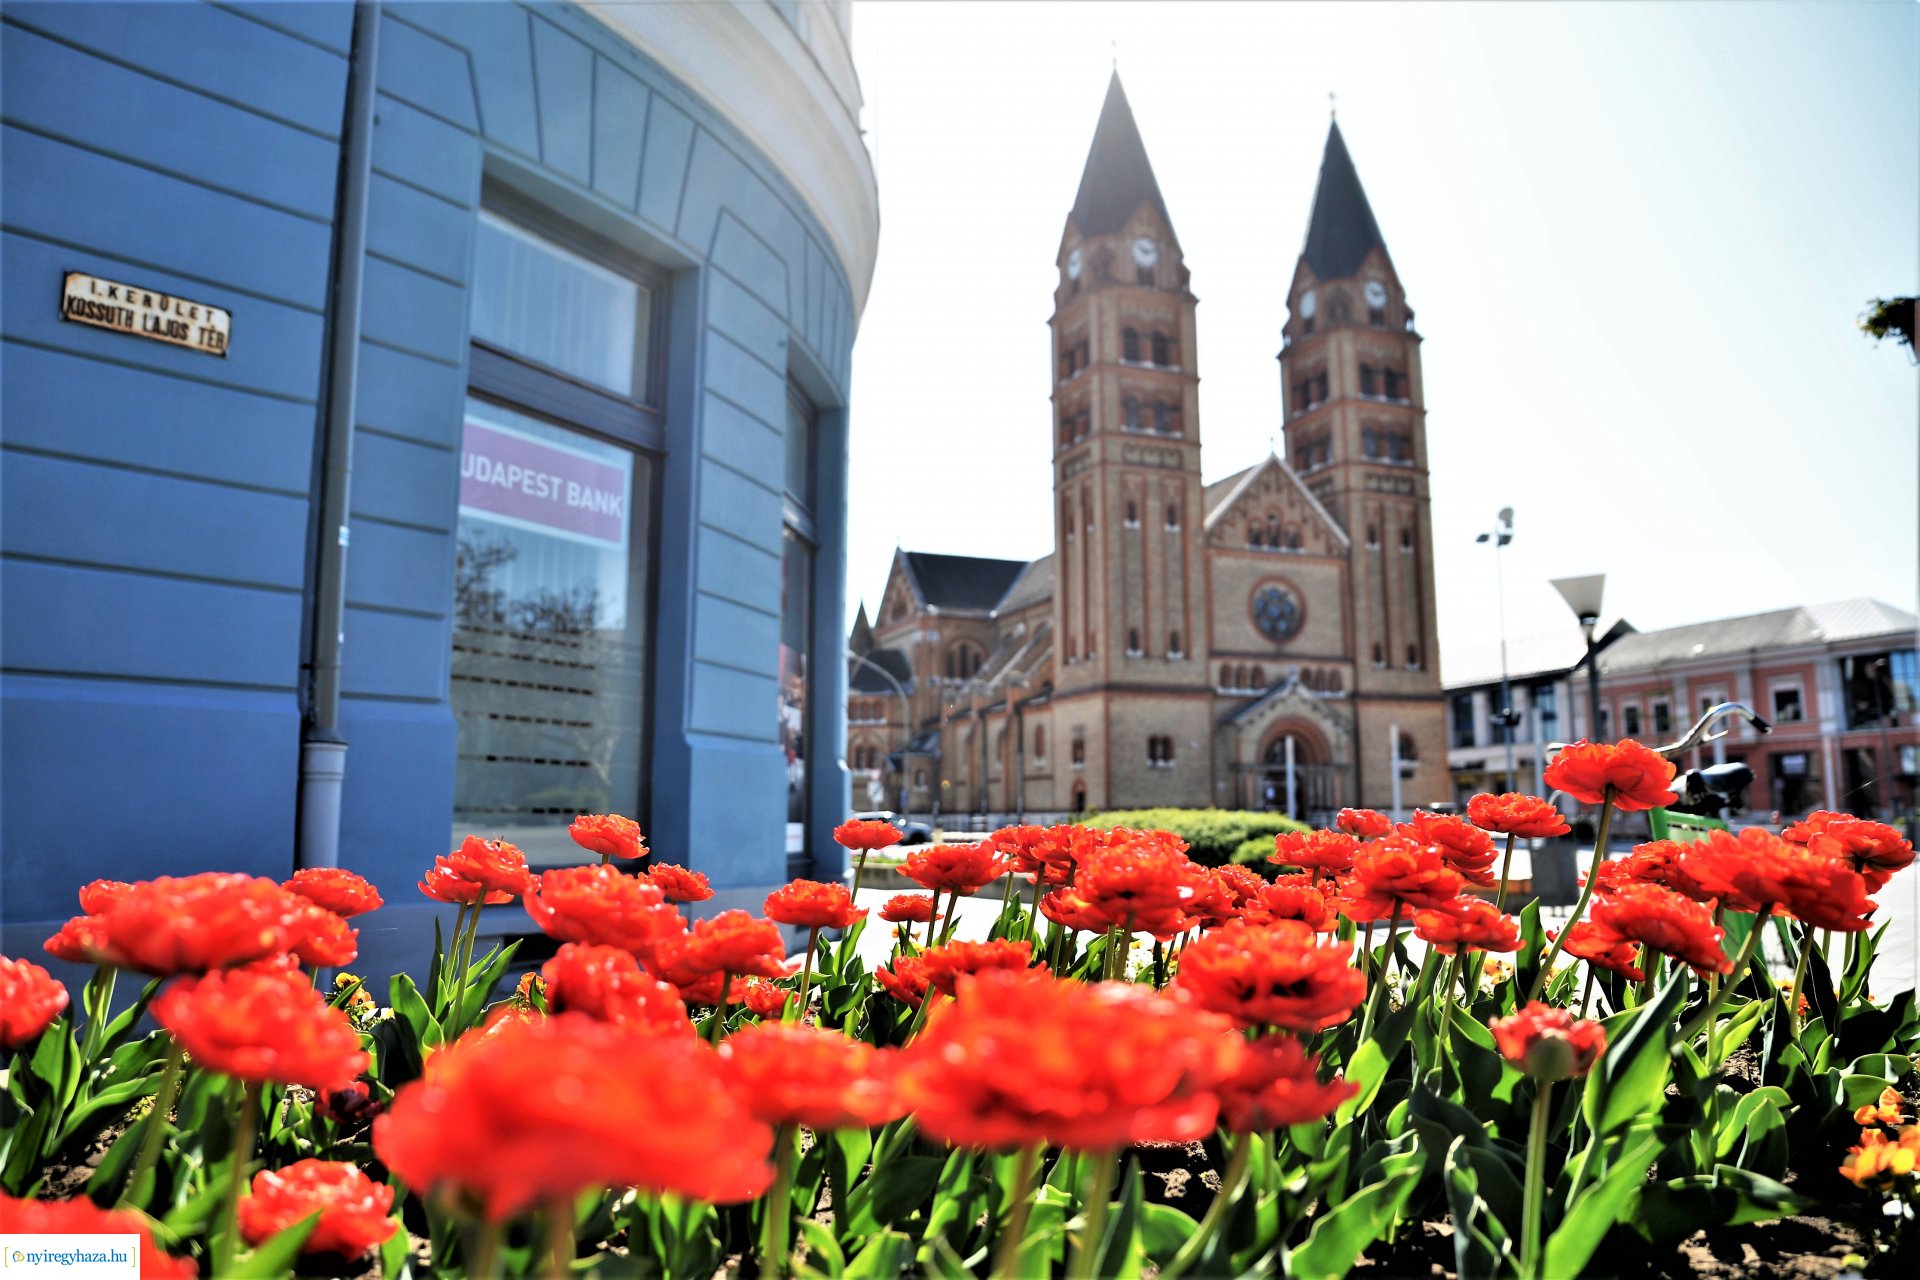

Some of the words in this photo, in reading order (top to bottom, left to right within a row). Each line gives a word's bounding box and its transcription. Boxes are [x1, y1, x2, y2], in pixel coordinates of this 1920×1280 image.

[66, 295, 134, 329] KOSSUTH
[143, 312, 190, 341] LAJOS
[198, 324, 225, 349] TÉR
[566, 481, 623, 518] BANK
